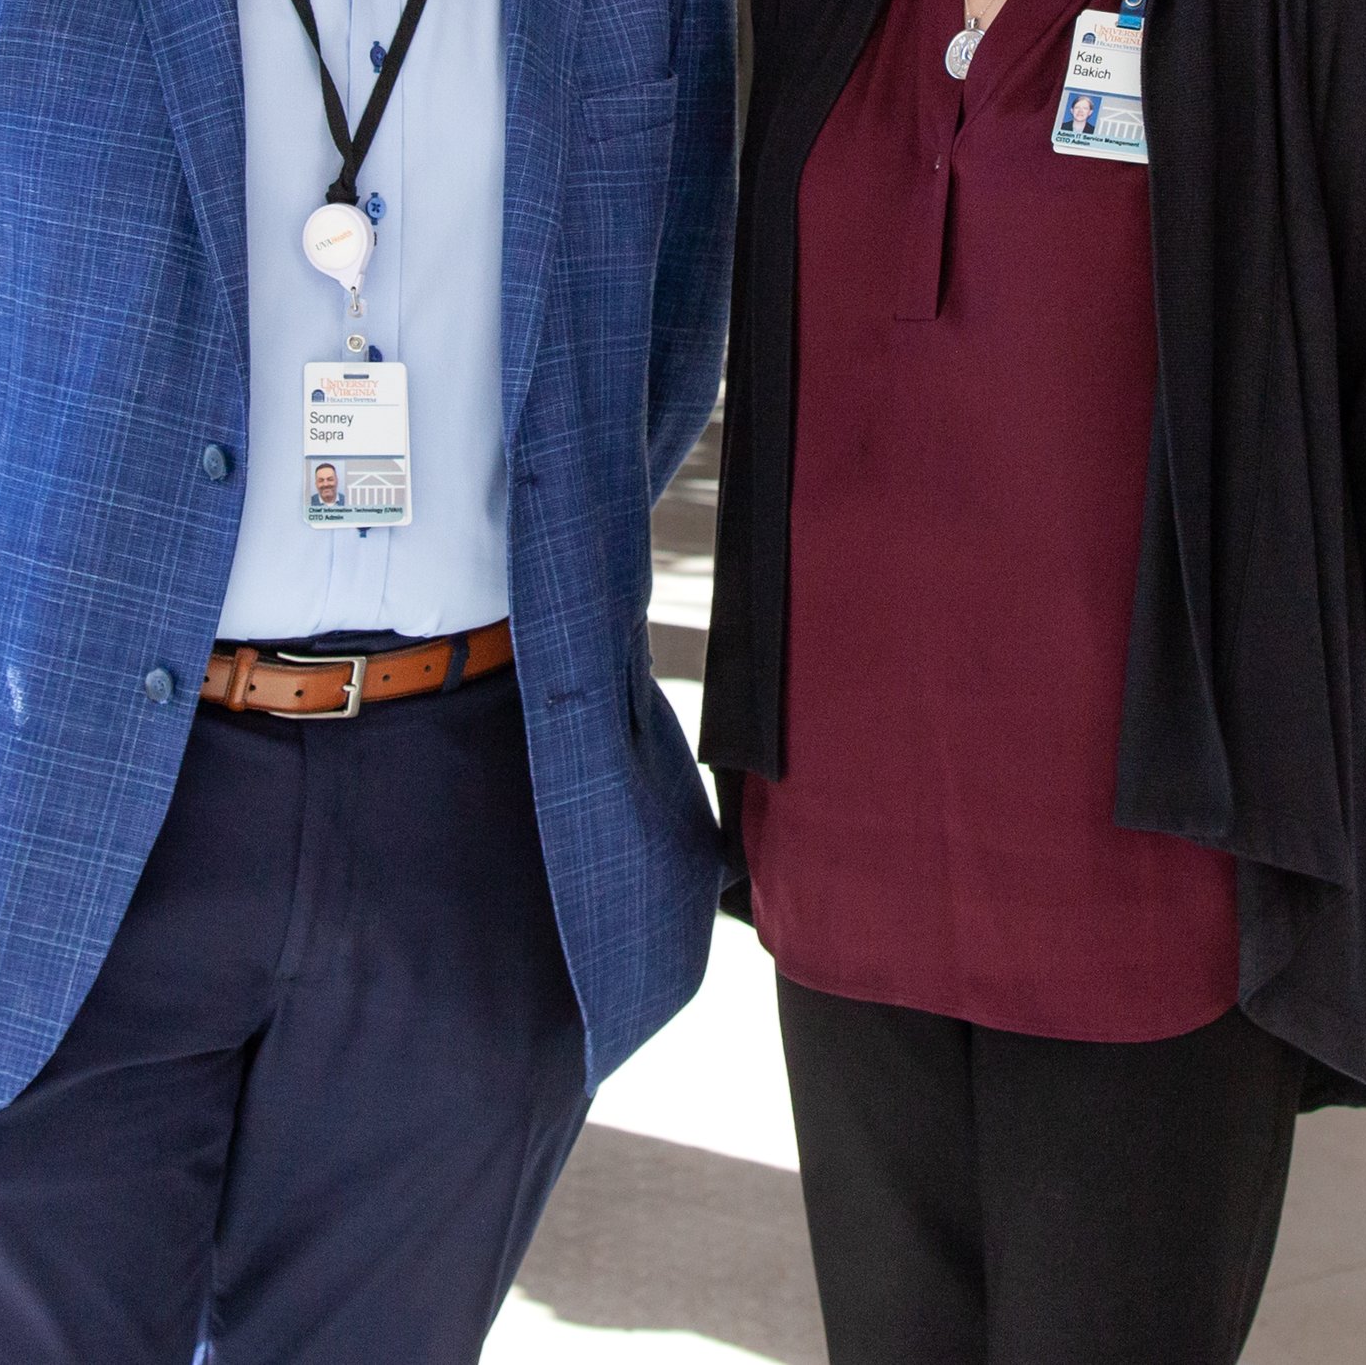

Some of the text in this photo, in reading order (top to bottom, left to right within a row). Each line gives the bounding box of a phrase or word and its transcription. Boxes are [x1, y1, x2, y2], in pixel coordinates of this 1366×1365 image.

[1076, 51, 1103, 64] Kate
[1073, 64, 1111, 80] Bakich
[1104, 138, 1140, 147] Management
[310, 411, 354, 427] Sonney
[310, 427, 344, 443] Sapra
